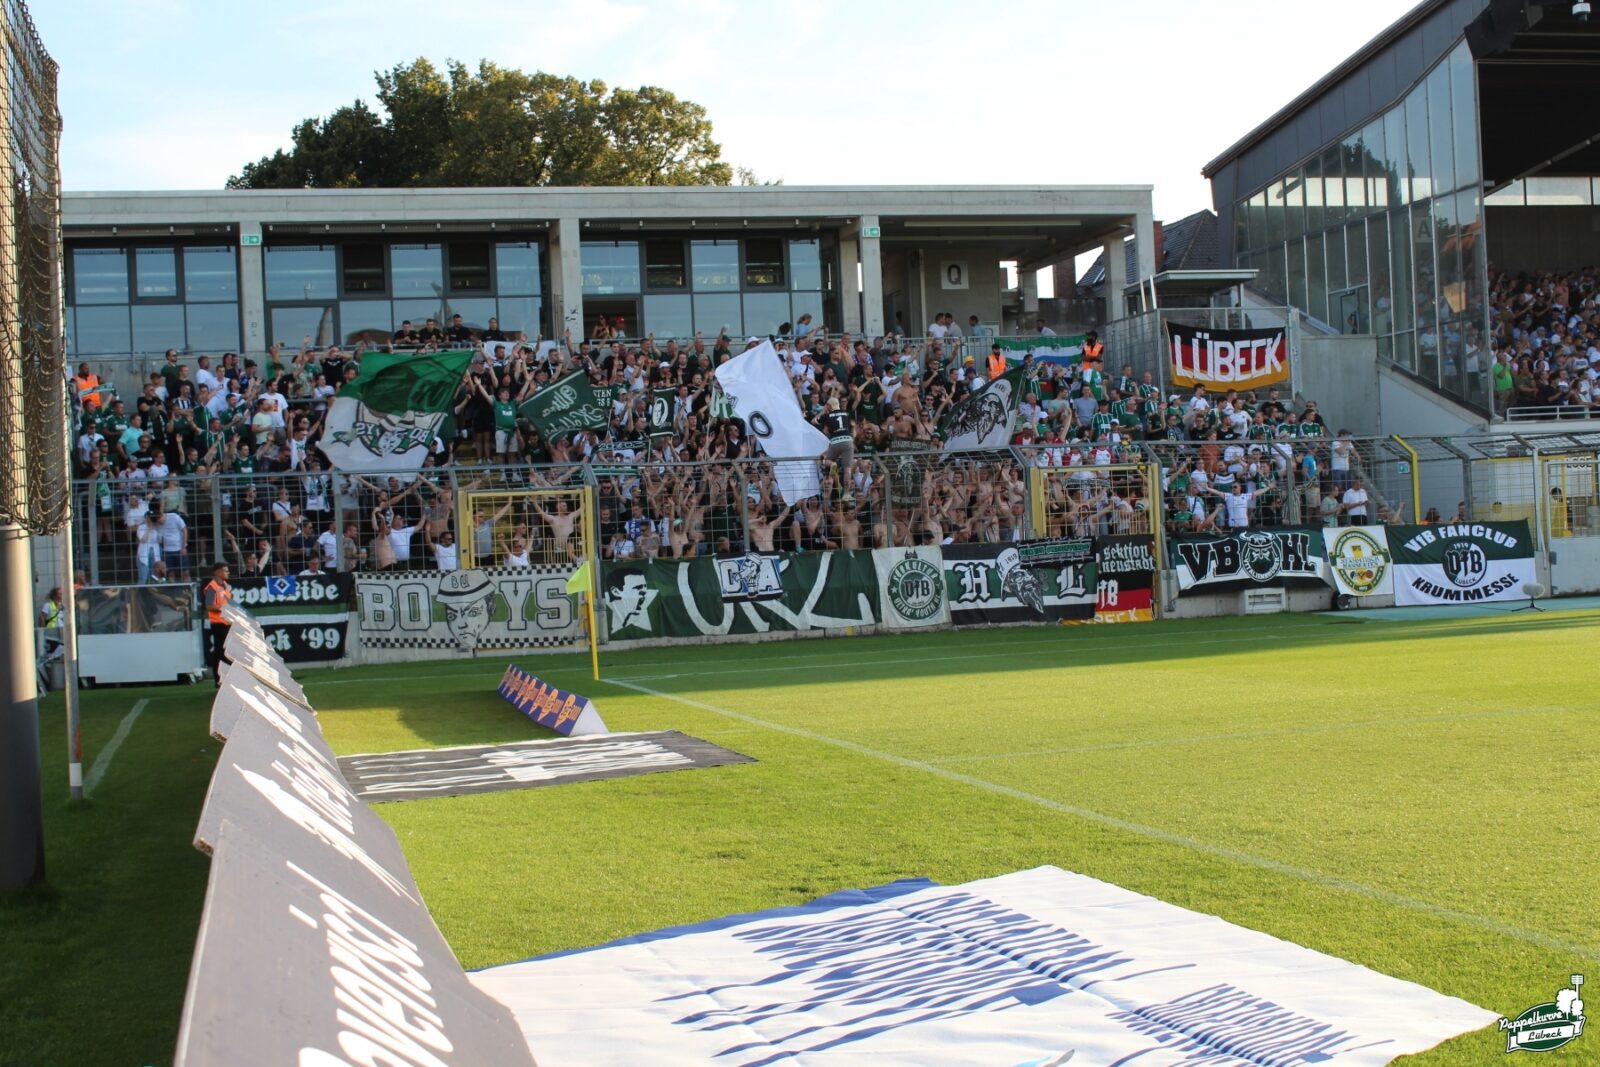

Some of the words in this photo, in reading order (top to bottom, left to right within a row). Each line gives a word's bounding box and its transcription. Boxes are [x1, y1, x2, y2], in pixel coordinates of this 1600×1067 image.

[947, 264, 962, 286] Q
[1174, 332, 1283, 382] LÜBECK
[1403, 530, 1437, 552] VfB
[1438, 524, 1518, 549] FANCLUB
[953, 562, 992, 603] H
[1412, 573, 1519, 601] KRUMMESSE
[357, 577, 573, 632] BOYS
